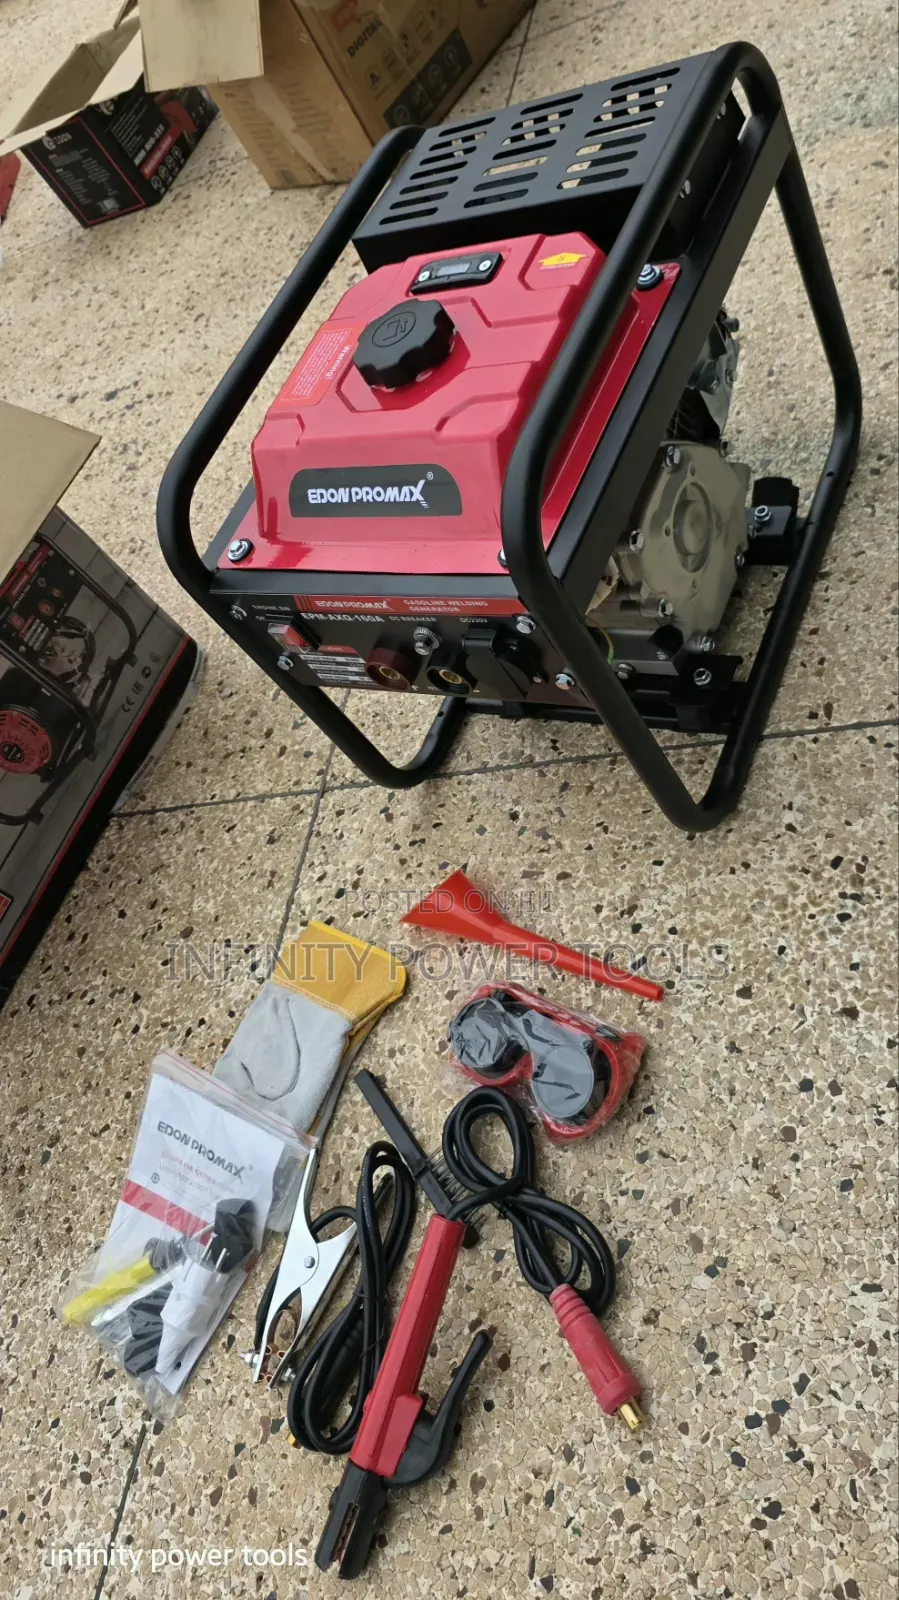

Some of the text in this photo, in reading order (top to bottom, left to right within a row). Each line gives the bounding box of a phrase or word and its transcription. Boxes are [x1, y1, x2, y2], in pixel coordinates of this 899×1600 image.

[300, 612, 385, 622] EPM-AXQ-160A
[157, 1120, 247, 1182] EDON PROMAX
